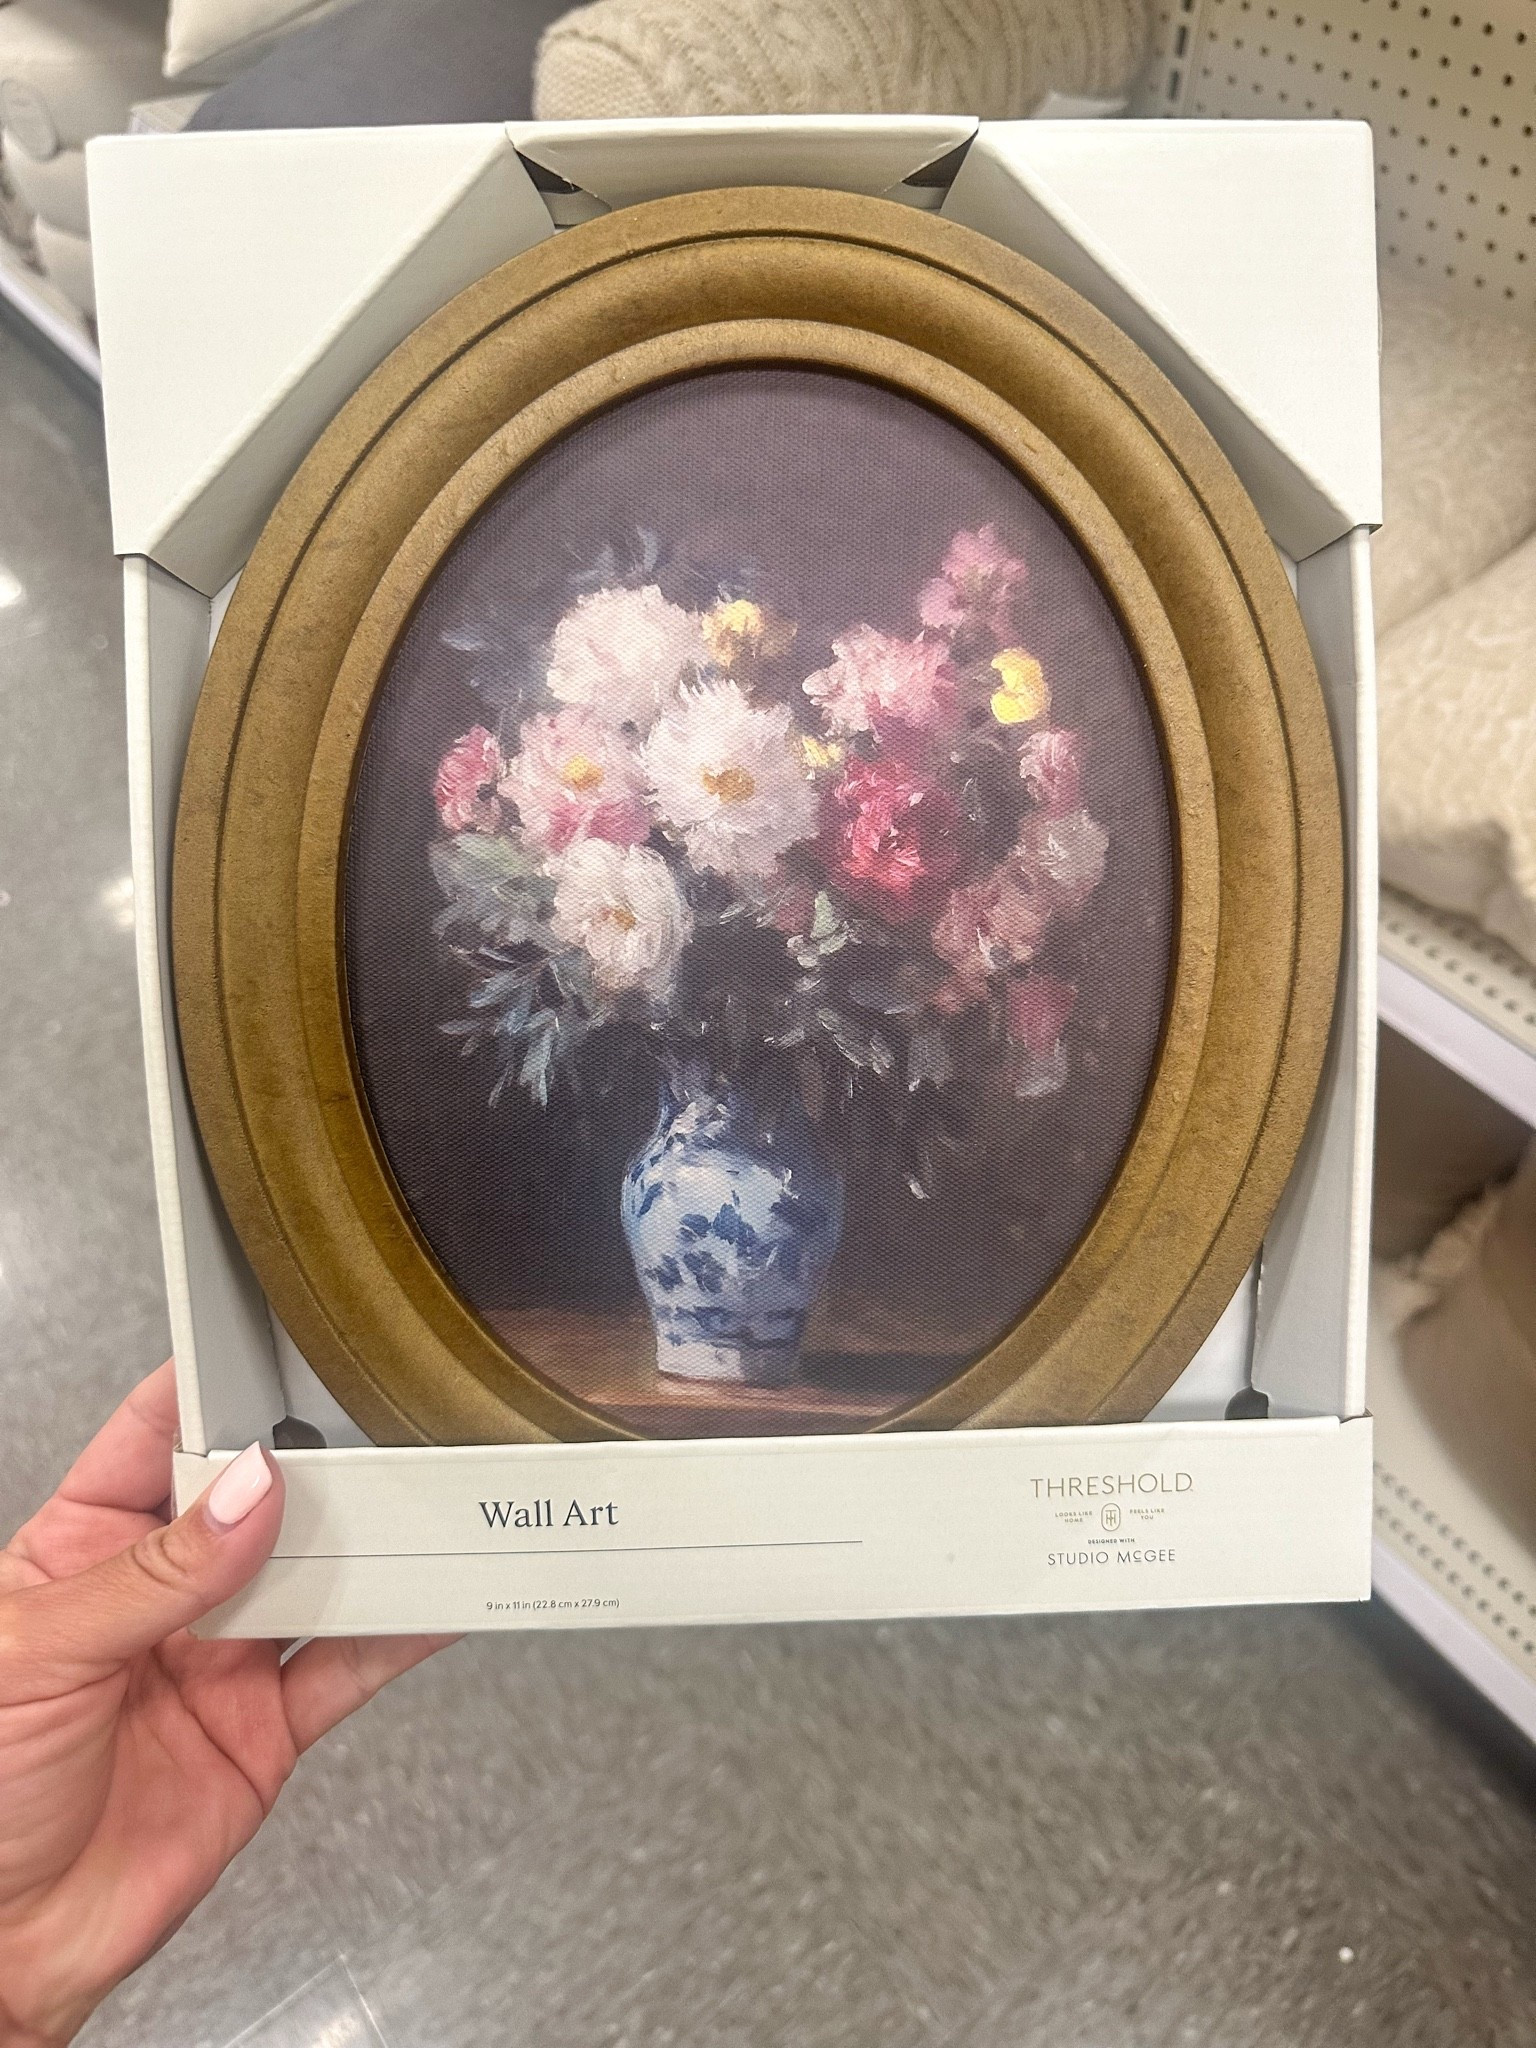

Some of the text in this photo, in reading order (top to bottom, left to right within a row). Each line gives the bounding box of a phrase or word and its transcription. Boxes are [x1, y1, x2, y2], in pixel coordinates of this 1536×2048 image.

[1030, 1473, 1192, 1497] THRESHOLD
[478, 1499, 619, 1528] Wall Art
[1048, 1552, 1108, 1565] STUDIO
[487, 1602, 493, 1610] 9
[495, 1602, 503, 1610] in
[533, 1601, 556, 1610] (22.8
[582, 1599, 601, 1607] 27.9
[603, 1599, 619, 1608] cm)
